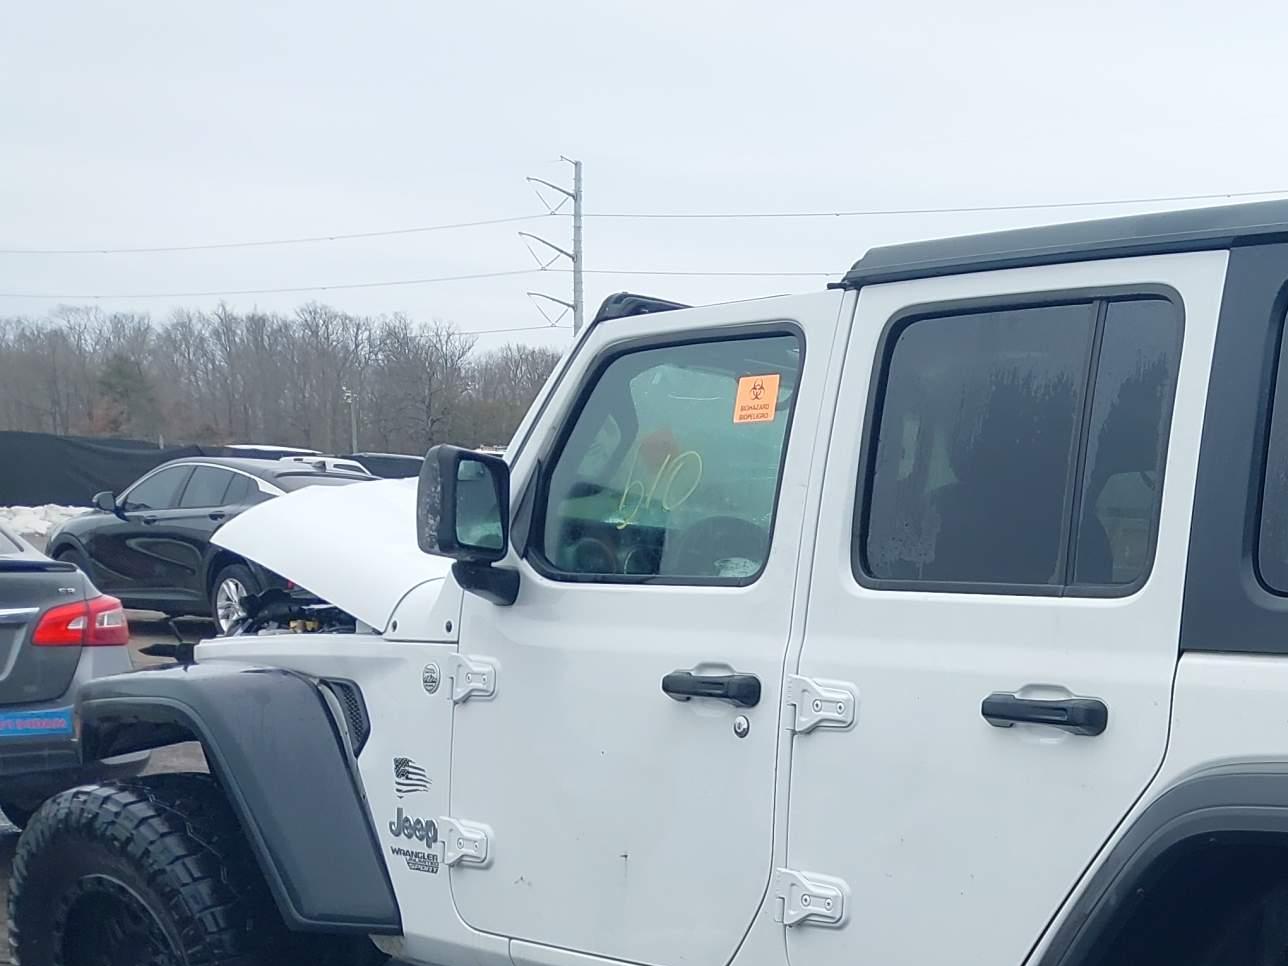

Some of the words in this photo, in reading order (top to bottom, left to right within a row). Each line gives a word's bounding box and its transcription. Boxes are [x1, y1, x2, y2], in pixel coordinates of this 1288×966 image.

[389, 807, 438, 849] Jeep
[390, 845, 438, 862] WRANGLER
[409, 863, 438, 873] SPORT
